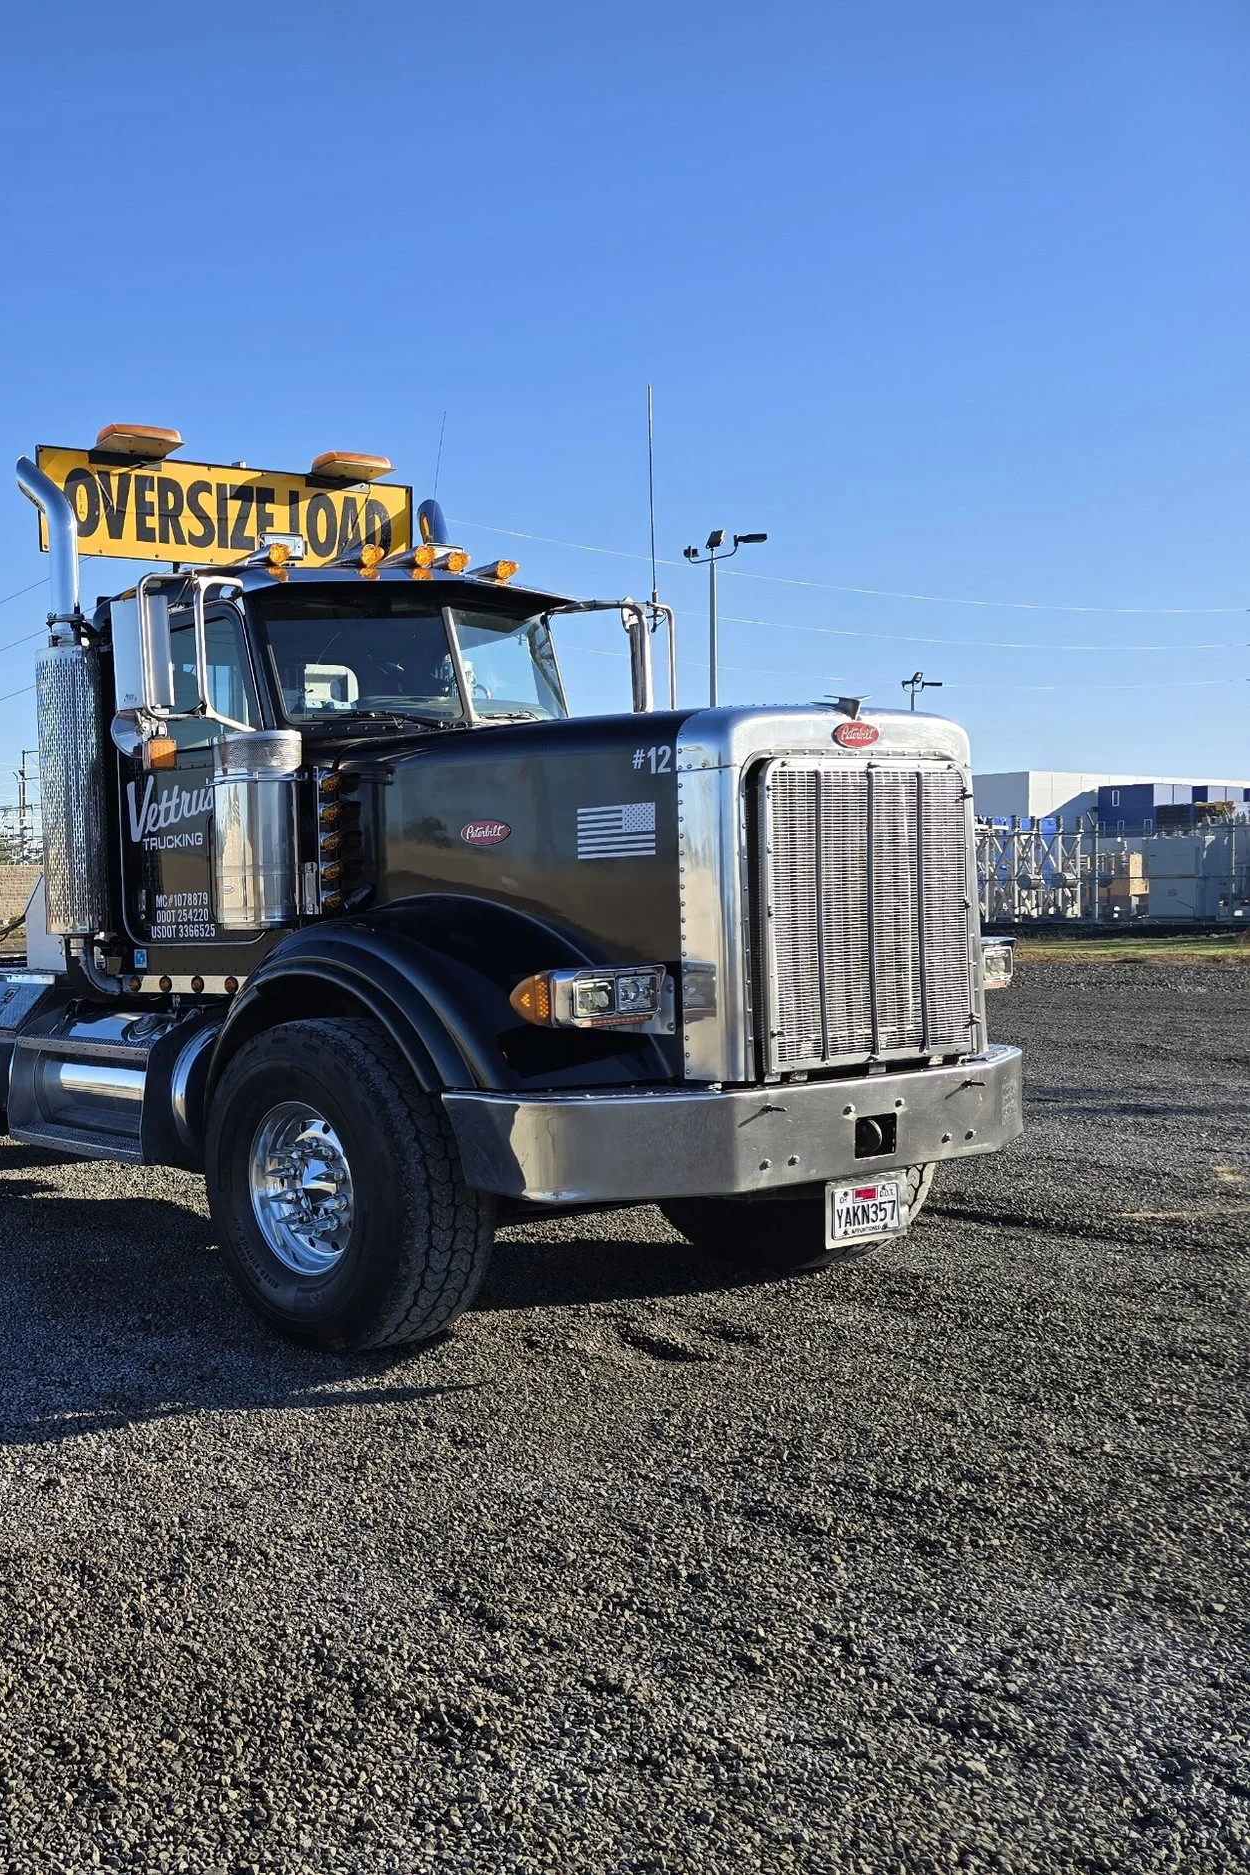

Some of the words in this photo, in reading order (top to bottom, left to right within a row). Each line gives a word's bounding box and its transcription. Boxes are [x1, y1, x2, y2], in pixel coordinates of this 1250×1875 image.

[64, 467, 275, 550] OVERSIZE
[289, 490, 392, 559] LOAD
[841, 725, 877, 741] Peterbilt
[632, 745, 672, 774] #12
[466, 824, 505, 840] Peterbilt
[142, 832, 203, 851] TRUCKING
[156, 909, 176, 923] ODOT
[177, 908, 209, 922] 254220
[151, 925, 177, 938] USDOT
[178, 924, 215, 937] 3366525
[836, 1200, 896, 1229] YAKN357
